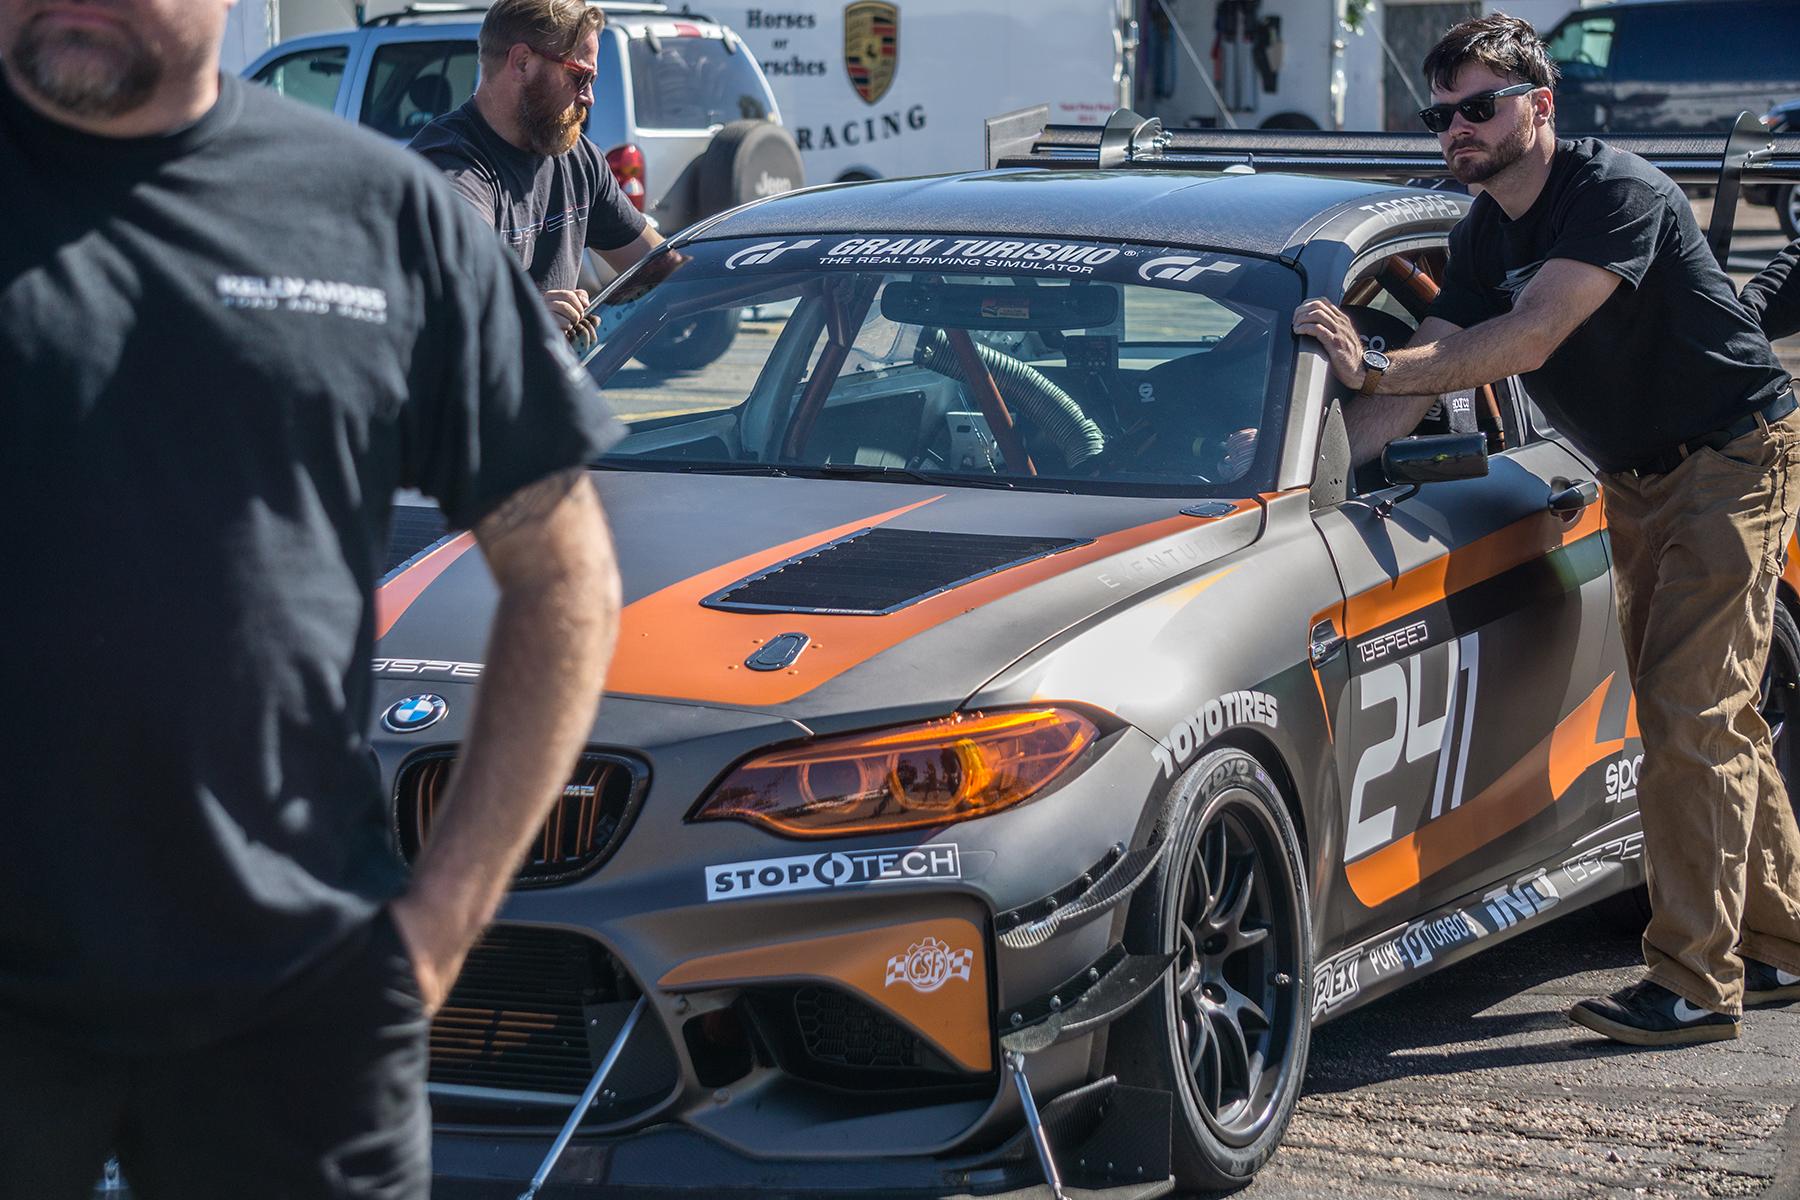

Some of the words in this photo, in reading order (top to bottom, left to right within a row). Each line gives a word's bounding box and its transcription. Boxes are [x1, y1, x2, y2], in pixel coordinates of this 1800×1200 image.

[746, 10, 816, 29] Horses
[772, 39, 788, 49] or
[763, 56, 827, 76] rsches
[796, 104, 927, 151] RACING
[755, 171, 792, 195] Jeep
[827, 238, 944, 256] GRAN
[942, 239, 1121, 265] TURISMO
[819, 256, 854, 265] THE
[855, 256, 902, 265] REAL
[905, 257, 980, 266] DRIVING
[984, 258, 1094, 275] SIMULATOR
[1356, 620, 1429, 664] TYSPEED
[1343, 631, 1479, 862] 241
[1201, 758, 1249, 799] TOYO
[1560, 831, 1644, 884] TYSPE
